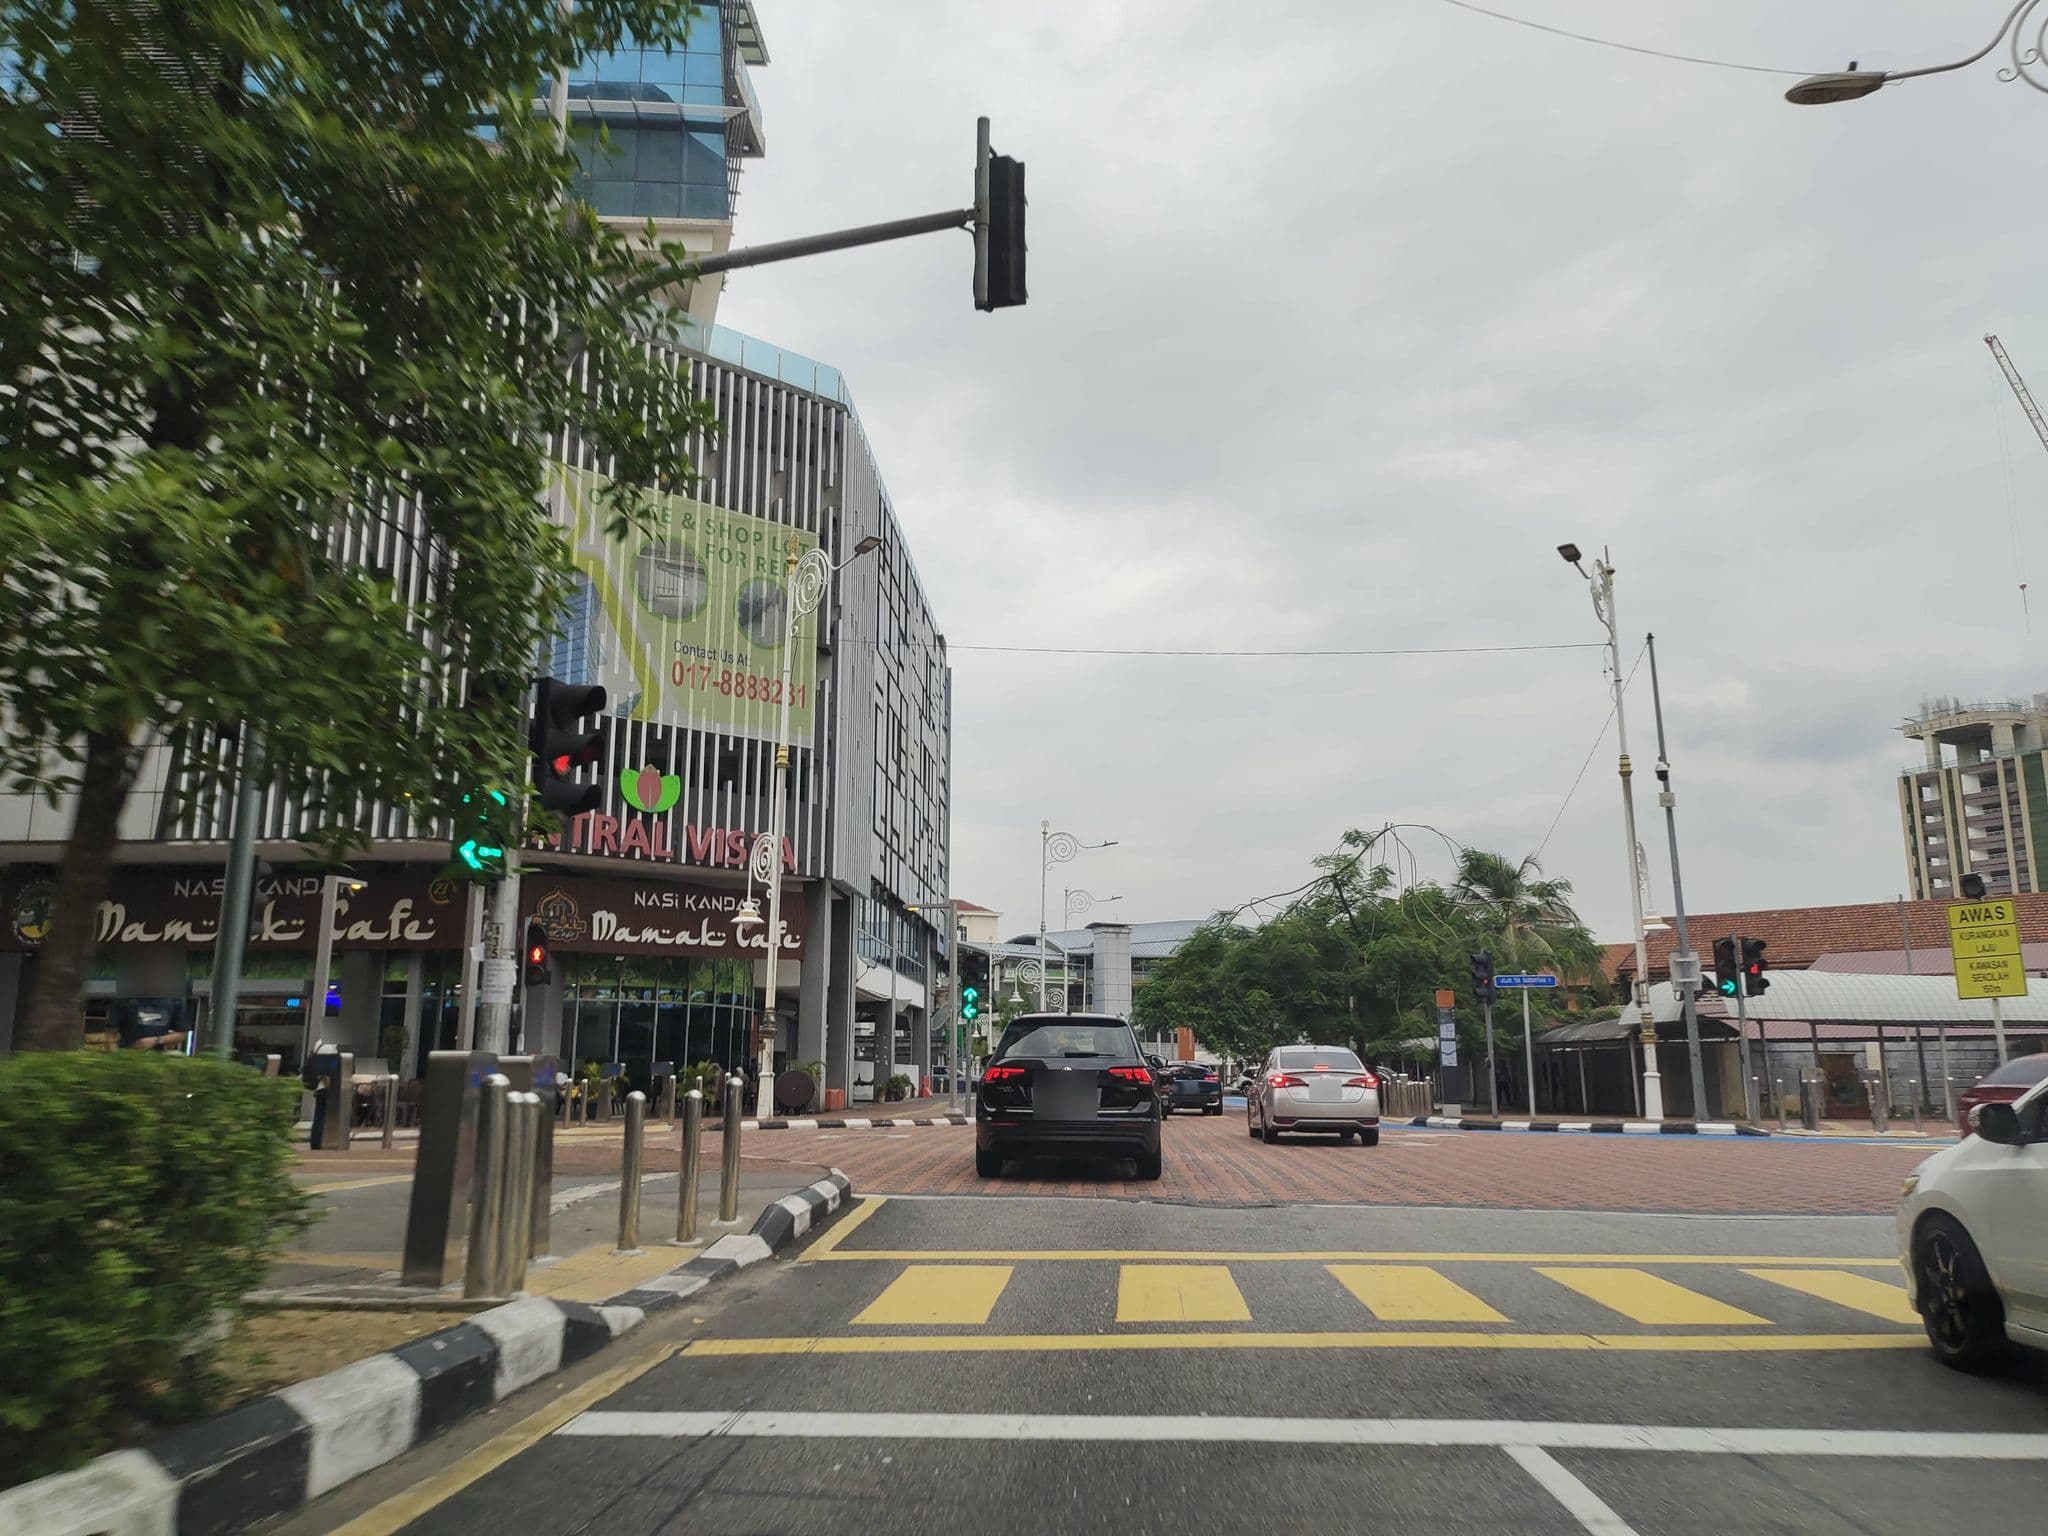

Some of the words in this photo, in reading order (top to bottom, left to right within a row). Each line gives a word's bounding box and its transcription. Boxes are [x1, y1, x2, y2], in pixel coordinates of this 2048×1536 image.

[681, 512, 696, 531] &
[705, 518, 763, 546] SHOP
[705, 543, 747, 569] FOR
[674, 640, 717, 661] Contact
[720, 650, 734, 664] Us
[686, 824, 796, 872] VISA
[174, 879, 226, 898] NAS
[255, 878, 355, 897] KANDR
[93, 900, 305, 942] Mamk
[331, 898, 436, 941] Cafe
[1959, 905, 2005, 923] AWAS
[592, 910, 727, 947] Mamak
[736, 920, 801, 949] Cafe
